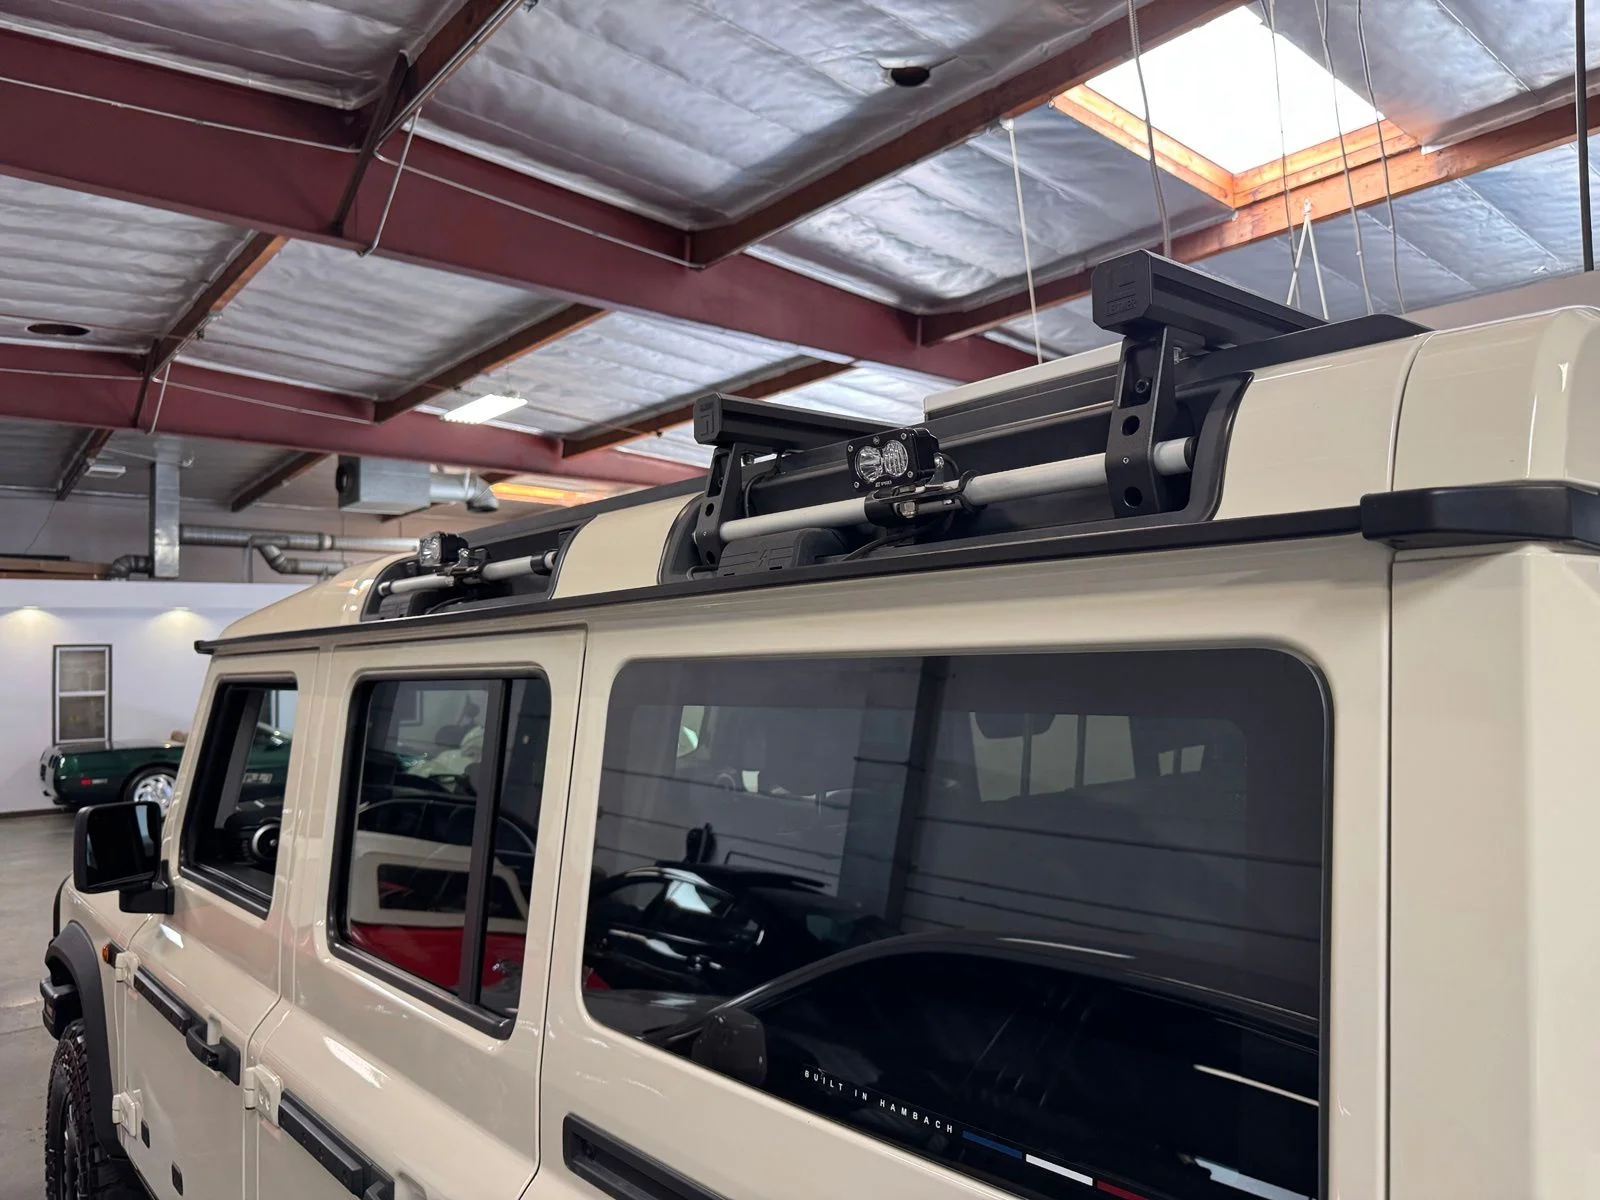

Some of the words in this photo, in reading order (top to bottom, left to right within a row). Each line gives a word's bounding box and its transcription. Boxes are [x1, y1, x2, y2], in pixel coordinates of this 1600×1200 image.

[804, 1069, 843, 1092] BUILT
[854, 1089, 868, 1101] IN
[879, 1098, 953, 1134] HAMBACH
